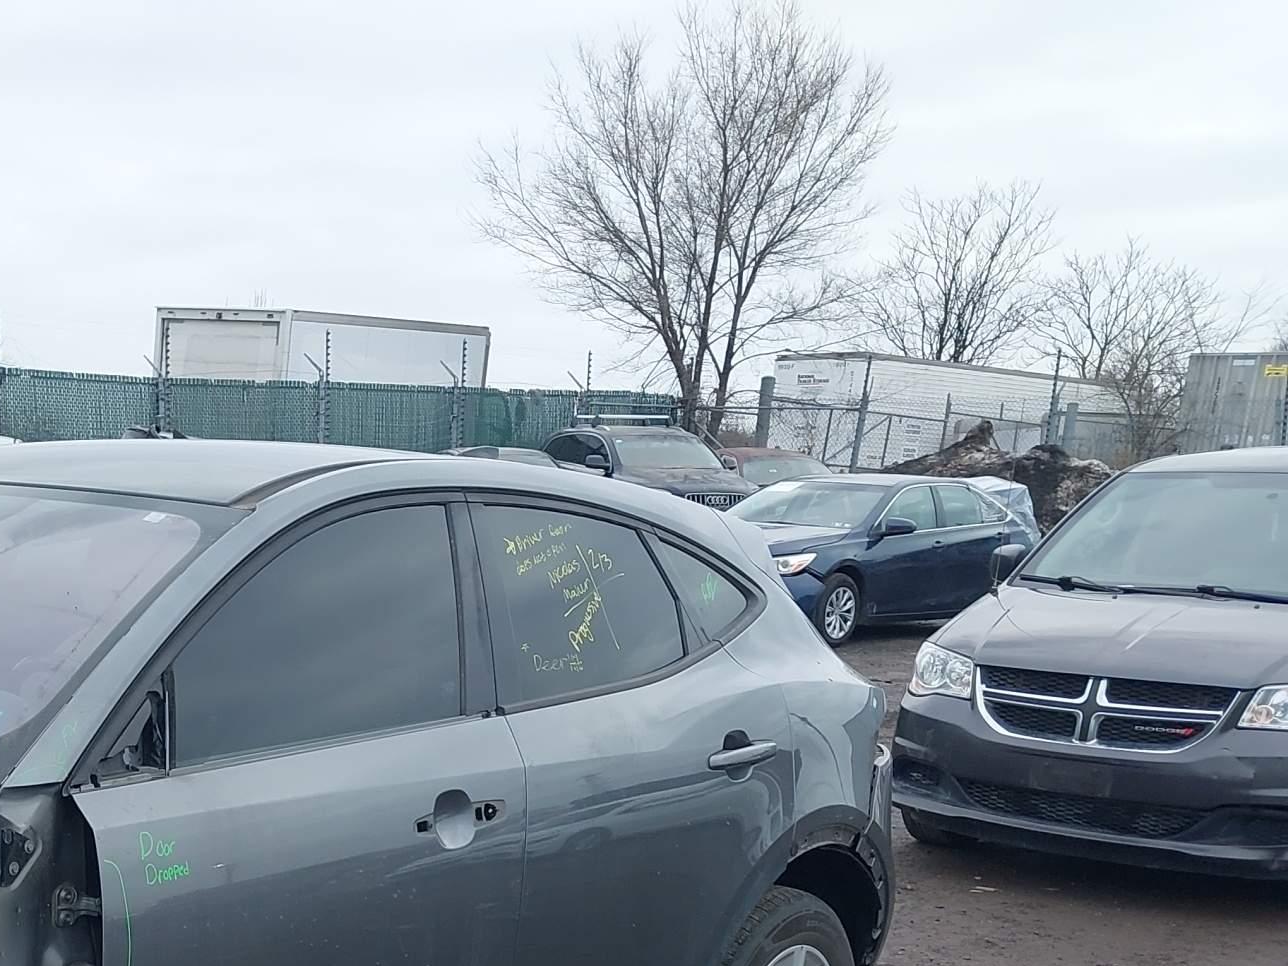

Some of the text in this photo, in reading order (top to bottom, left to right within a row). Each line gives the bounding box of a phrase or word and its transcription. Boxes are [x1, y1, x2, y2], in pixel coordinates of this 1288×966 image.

[1134, 725, 1184, 735] DODGE
[139, 831, 176, 860] Door
[144, 860, 190, 885] Dropped
